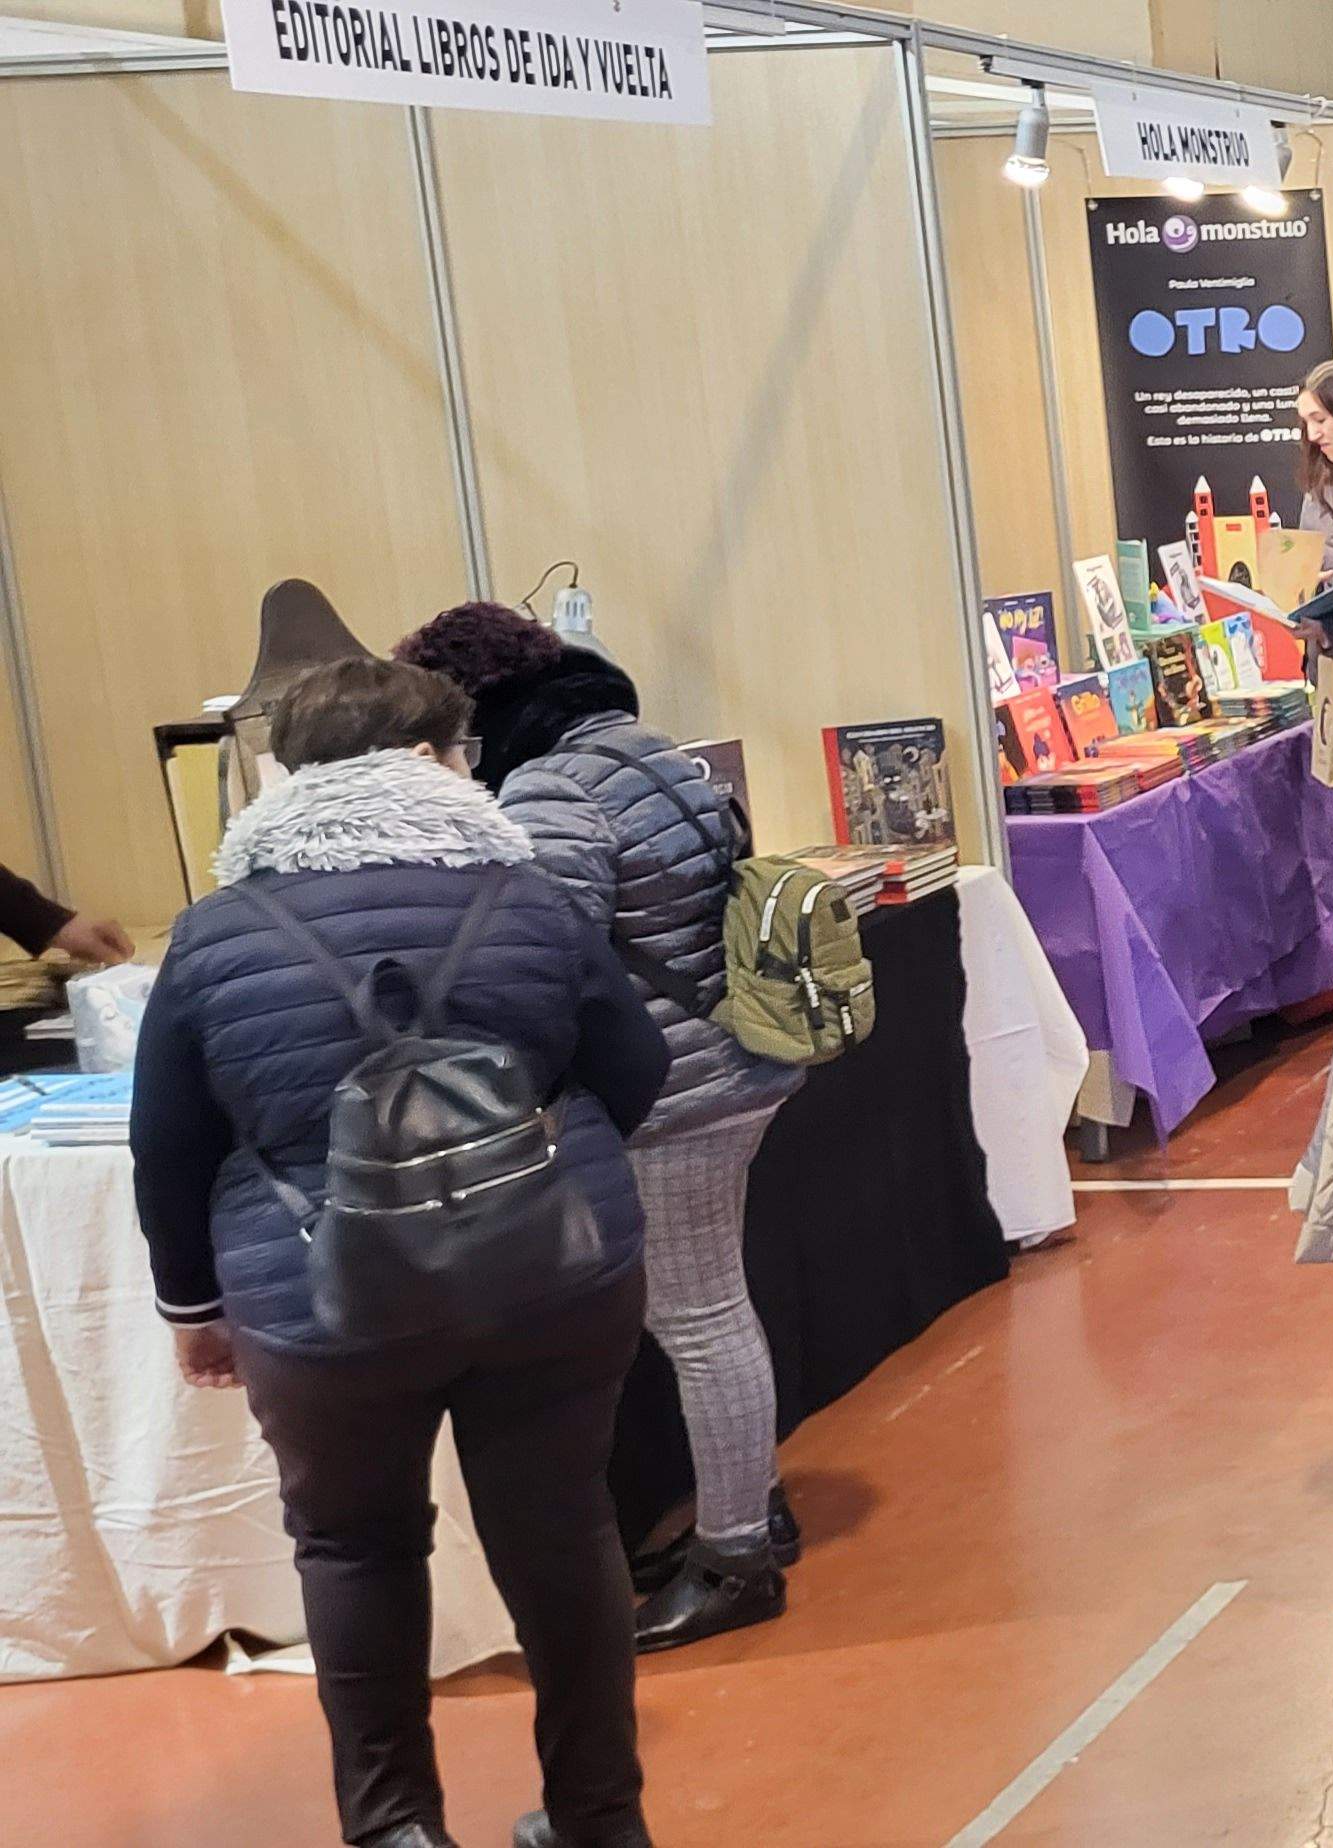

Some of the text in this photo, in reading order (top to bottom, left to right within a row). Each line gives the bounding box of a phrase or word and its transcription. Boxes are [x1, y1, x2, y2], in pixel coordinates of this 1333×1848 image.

[273, 0, 673, 100] EDITORIAL LIBROS DE IDA Y VUELTA
[1136, 121, 1251, 168] HOLA MONSTRUO
[1105, 217, 1308, 245] Hola monstruo
[1168, 278, 1199, 290] Paula
[1128, 304, 1305, 357] OTRO
[1134, 391, 1152, 402] Un
[1251, 387, 1268, 398] un
[1241, 402, 1251, 413] y
[1172, 435, 1187, 446] es
[1187, 434, 1200, 445] la
[1244, 432, 1260, 443] de
[1259, 427, 1302, 442] OTRO
